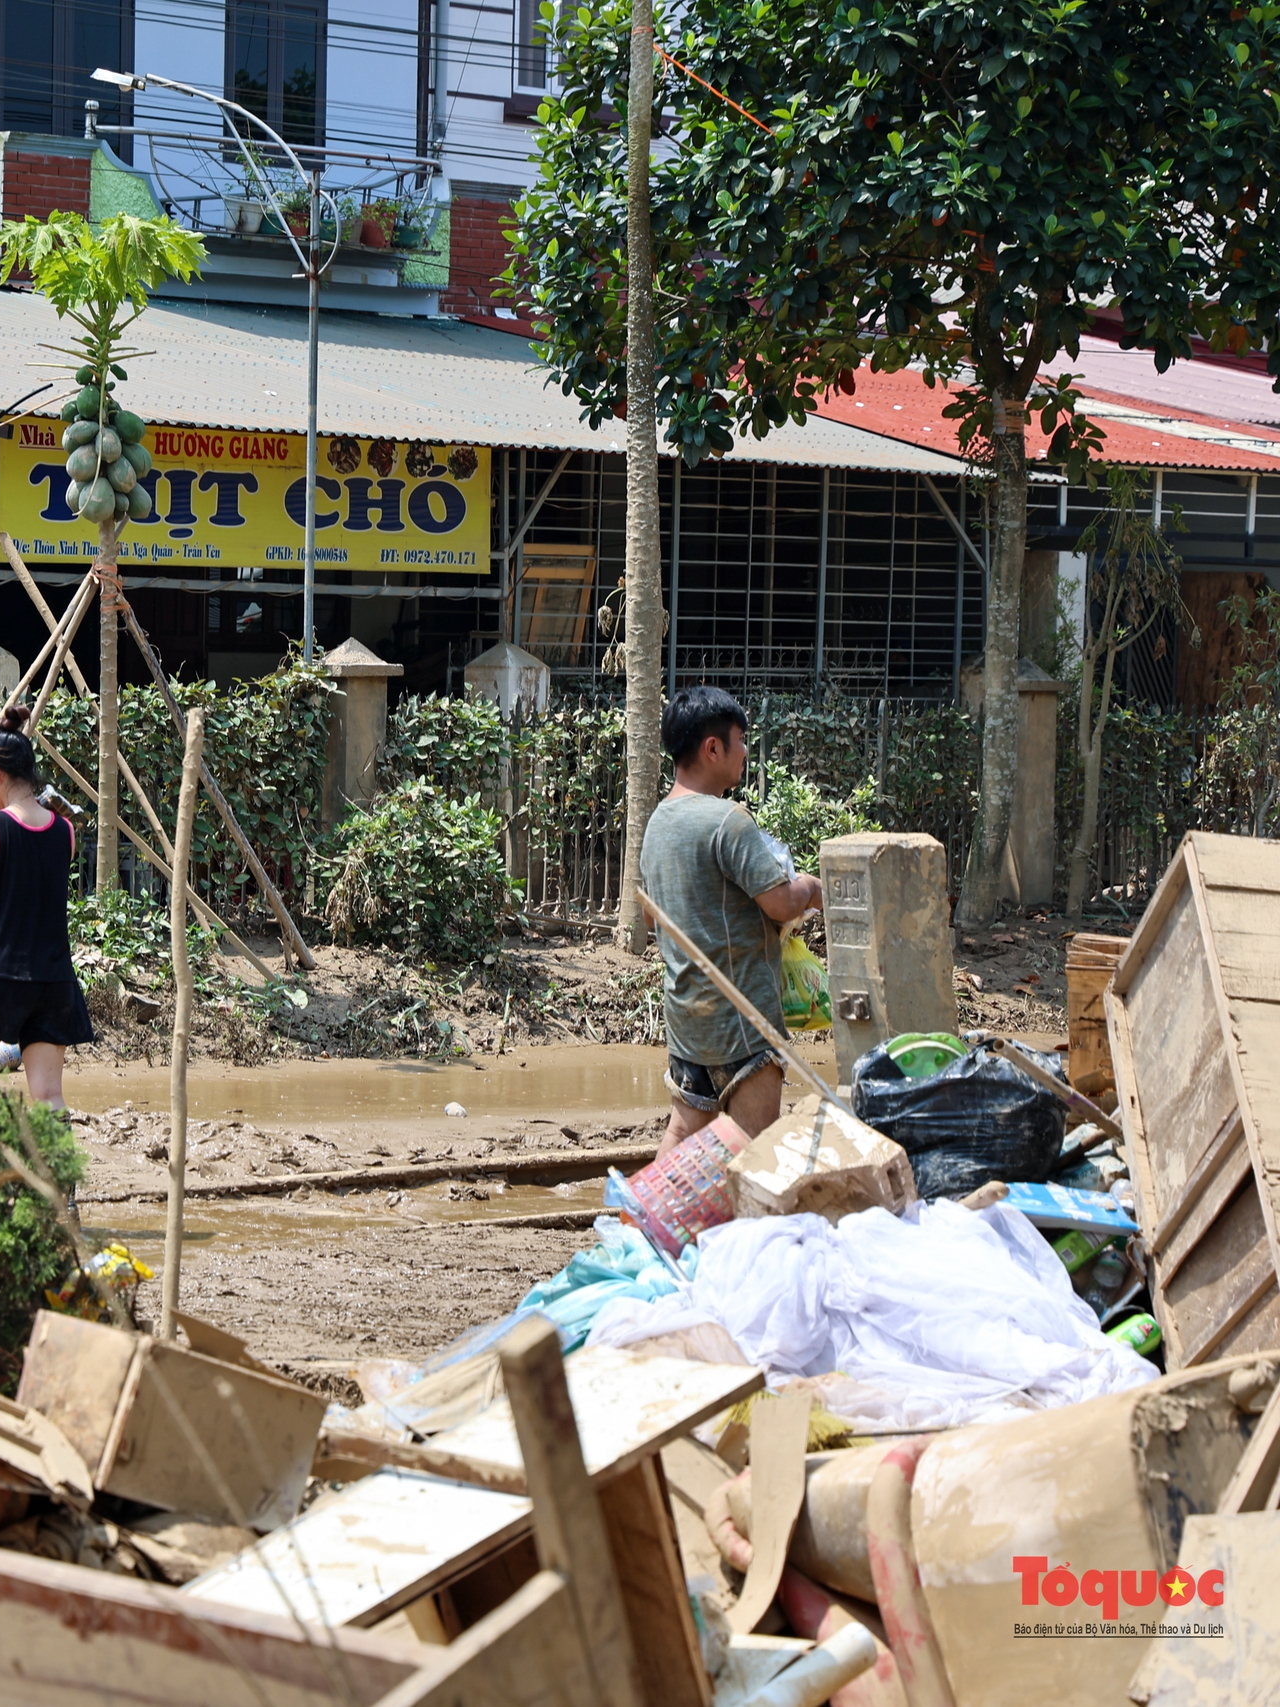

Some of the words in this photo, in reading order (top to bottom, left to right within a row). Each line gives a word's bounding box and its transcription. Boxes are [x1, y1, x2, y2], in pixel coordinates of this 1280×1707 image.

[19, 424, 56, 447] Nhà
[154, 431, 224, 458] HƯƠNG
[229, 436, 289, 460] GIANG
[284, 464, 467, 534] CHÓ
[33, 539, 55, 555] Thôn
[58, 540, 78, 555] Ninh
[151, 542, 173, 562] Quán
[205, 544, 221, 559] Yên
[404, 549, 476, 565] 0972.470.171
